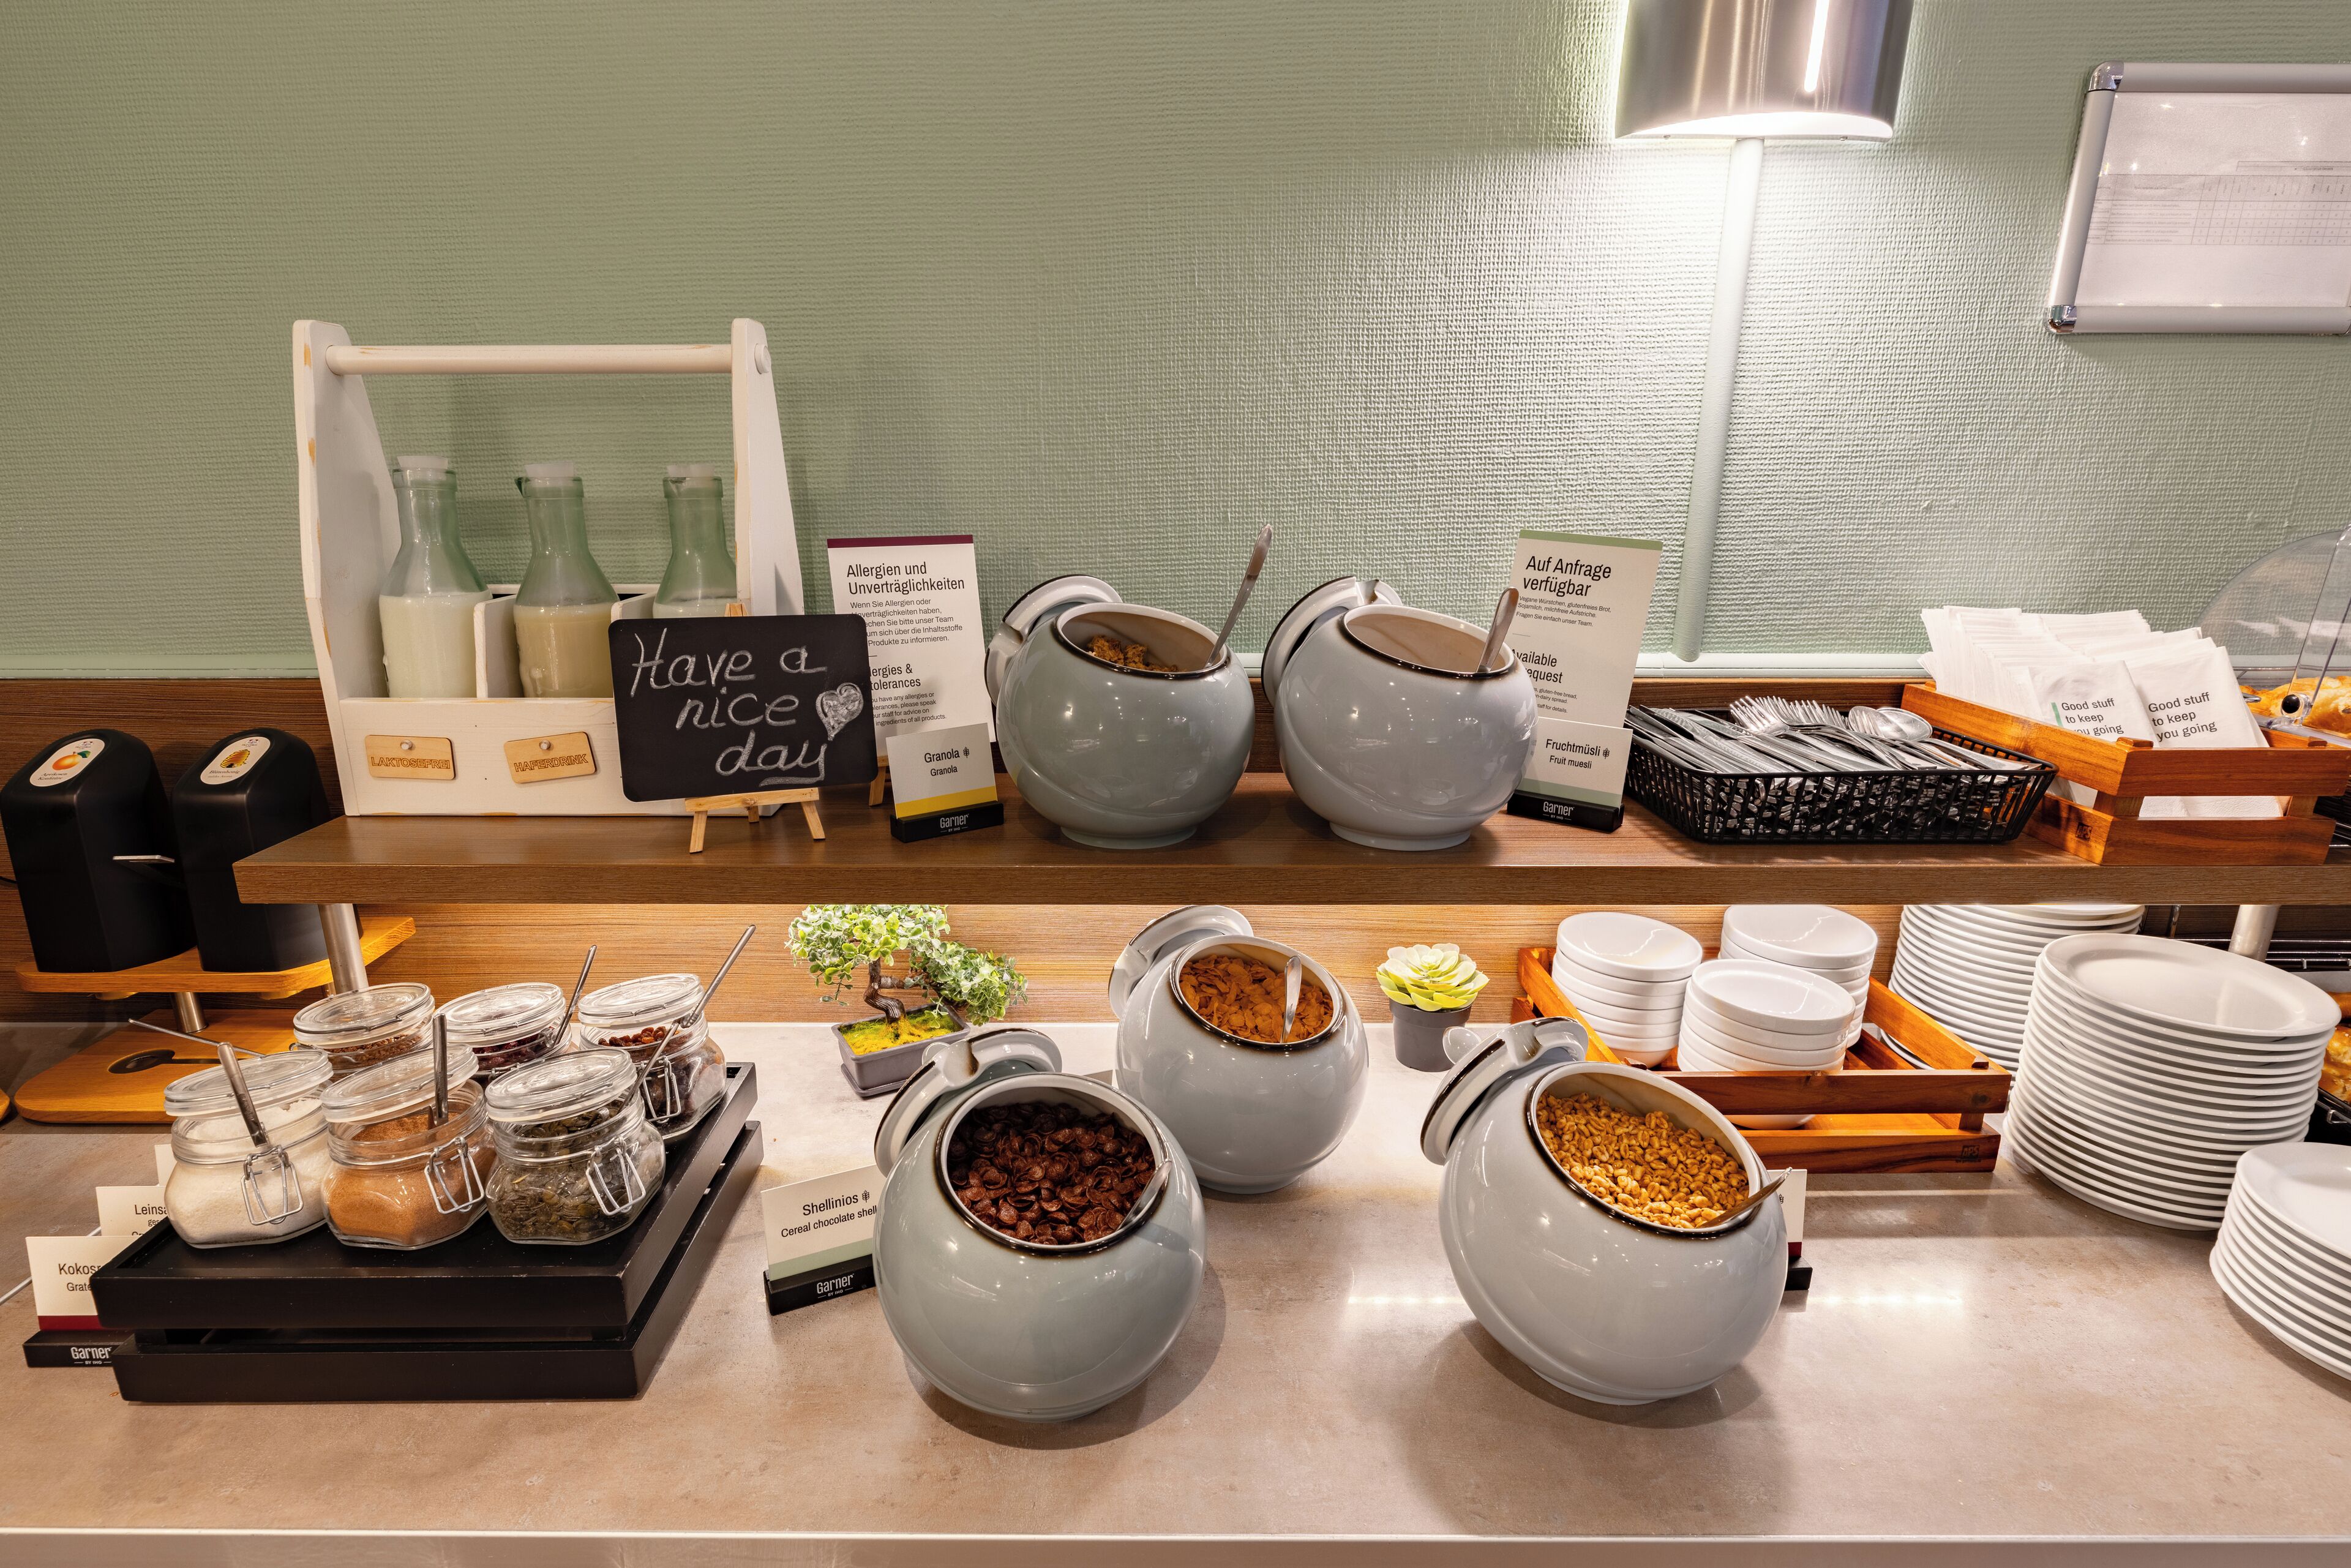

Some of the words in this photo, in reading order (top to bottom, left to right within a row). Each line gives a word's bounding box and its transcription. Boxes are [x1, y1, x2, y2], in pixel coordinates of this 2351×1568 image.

[847, 563, 901, 579] Allergien
[905, 561, 927, 575] und
[1526, 556, 1552, 572] Auf
[1553, 558, 1611, 581] Anfrage
[849, 577, 965, 595] Unverträglichkeiten
[1523, 576, 1591, 597] verfügbar
[1539, 598, 1567, 607] Würstchen,
[1567, 602, 1598, 611] glutenfreies
[1569, 609, 1597, 618] Aufstriche.
[923, 625, 963, 633] Inhaltsstoffe
[630, 628, 756, 697] Have
[779, 645, 827, 673] a
[869, 665, 902, 678] lergies
[906, 663, 913, 674] &
[1526, 668, 1563, 683] equest
[871, 678, 921, 691] tolerances
[675, 686, 800, 730] nice
[2061, 701, 2089, 711] Good
[2092, 698, 2115, 708] stuff
[2148, 698, 2181, 712] Good
[2184, 692, 2210, 705] stuff
[2077, 714, 2104, 722] keep
[2152, 718, 2164, 726] to
[2167, 711, 2196, 724] keep
[2093, 725, 2124, 736] going
[2157, 730, 2178, 742] you
[2183, 722, 2217, 737] going
[1546, 738, 1600, 757] Fruchtmüsli
[371, 756, 451, 769] LAKTOSEFREI
[514, 754, 588, 772] HAFERDRINK
[715, 729, 827, 787] day
[924, 749, 960, 763] Granola
[1550, 756, 1566, 765] Fruit
[1568, 759, 1592, 769] muesli
[931, 765, 958, 776] Granola
[1543, 801, 1573, 816] Garner
[940, 814, 969, 828] Garner
[803, 1195, 858, 1216] Shellinios
[781, 1222, 811, 1237] Cereal
[813, 1212, 855, 1229] chocolate
[67, 1282, 92, 1291] Grate
[817, 1274, 853, 1294] Garner
[70, 1346, 111, 1359] Garner
